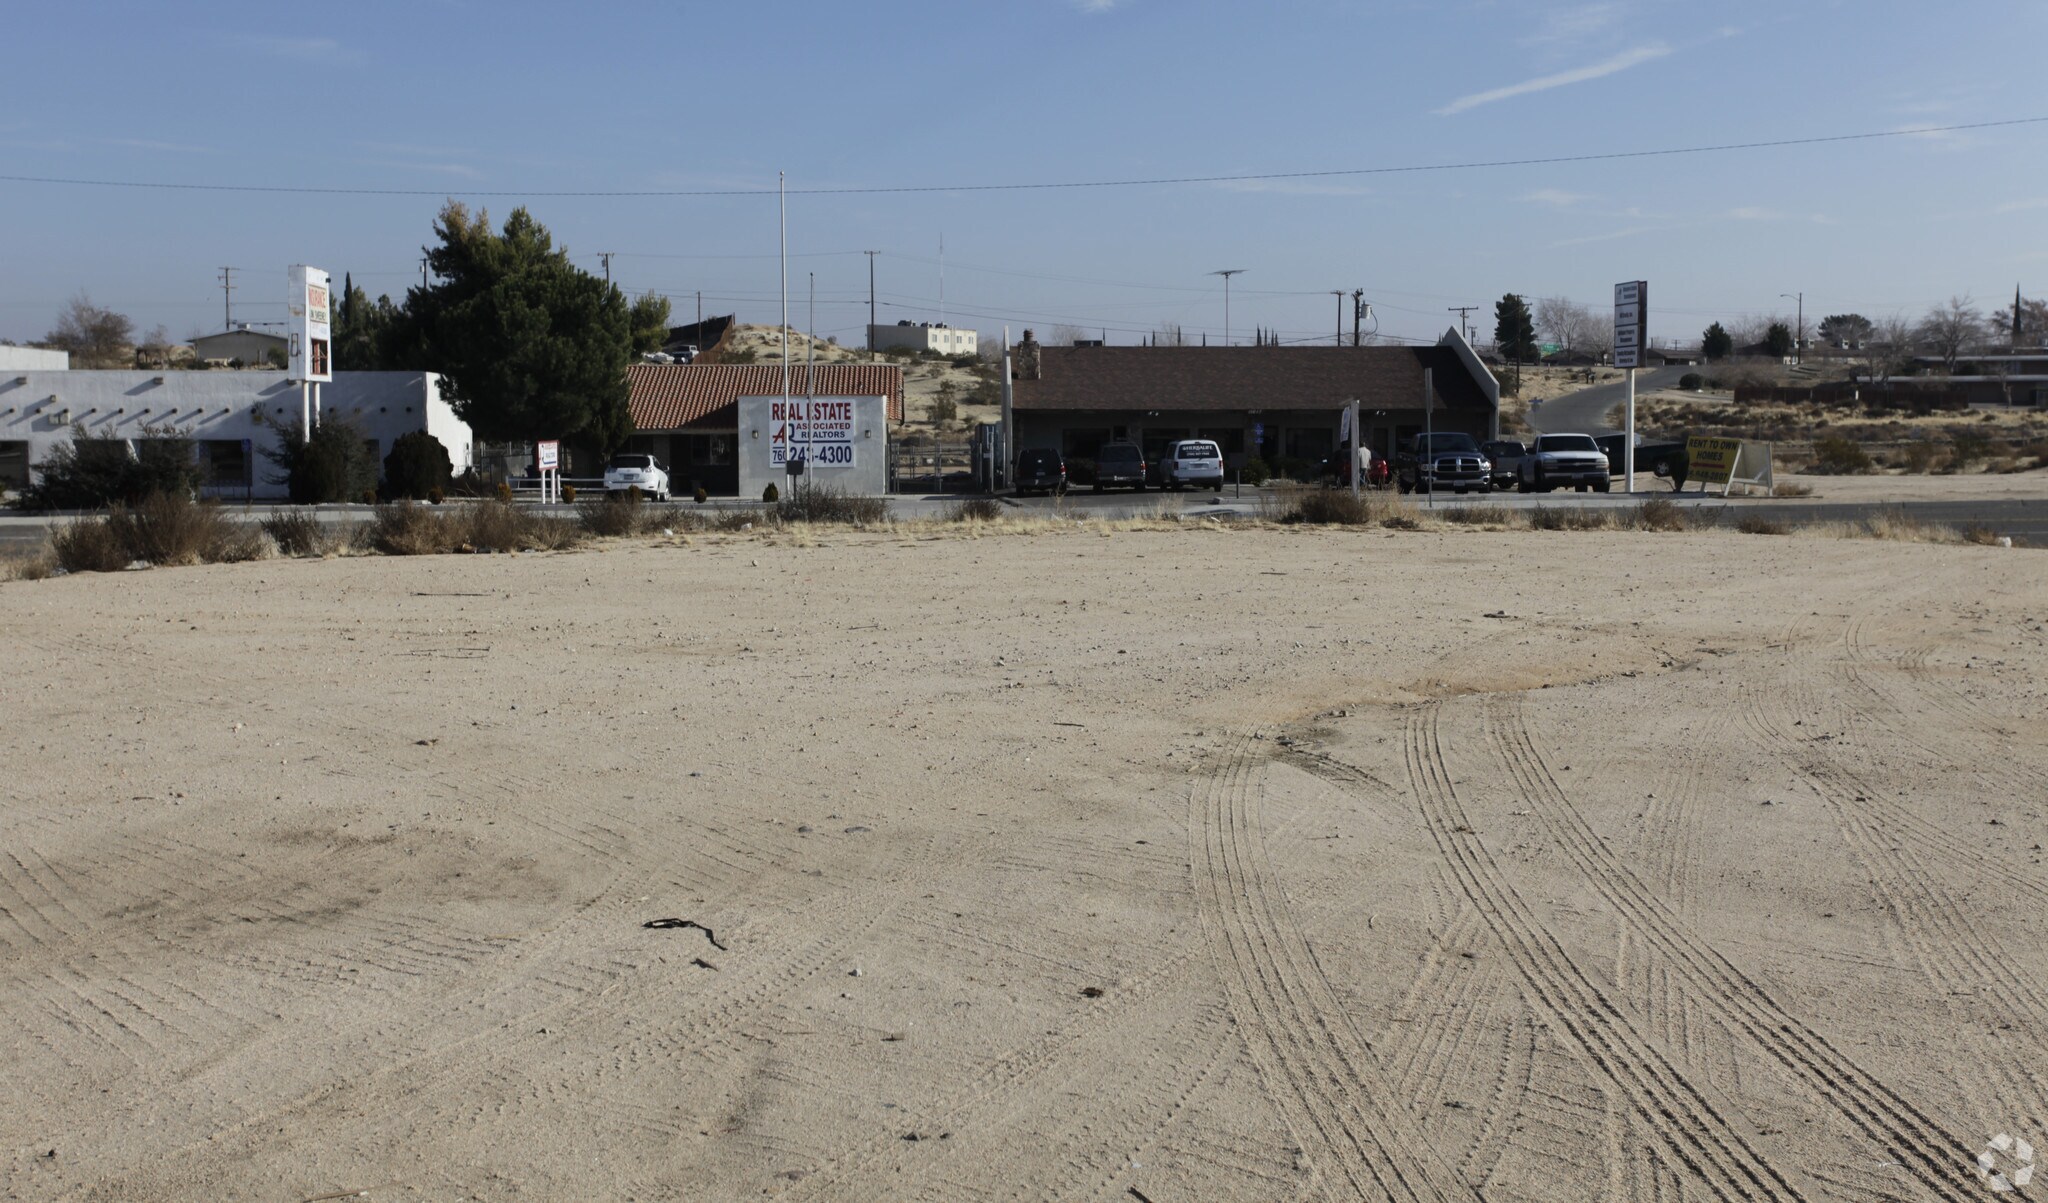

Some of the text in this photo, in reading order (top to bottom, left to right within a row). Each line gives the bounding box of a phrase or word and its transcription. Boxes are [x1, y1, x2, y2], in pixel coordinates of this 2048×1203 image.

[772, 403, 803, 420] REAL
[796, 422, 851, 430] ASOCIATED
[1689, 439, 1738, 450] RENT TO OWN
[1696, 451, 1723, 461] HOMES
